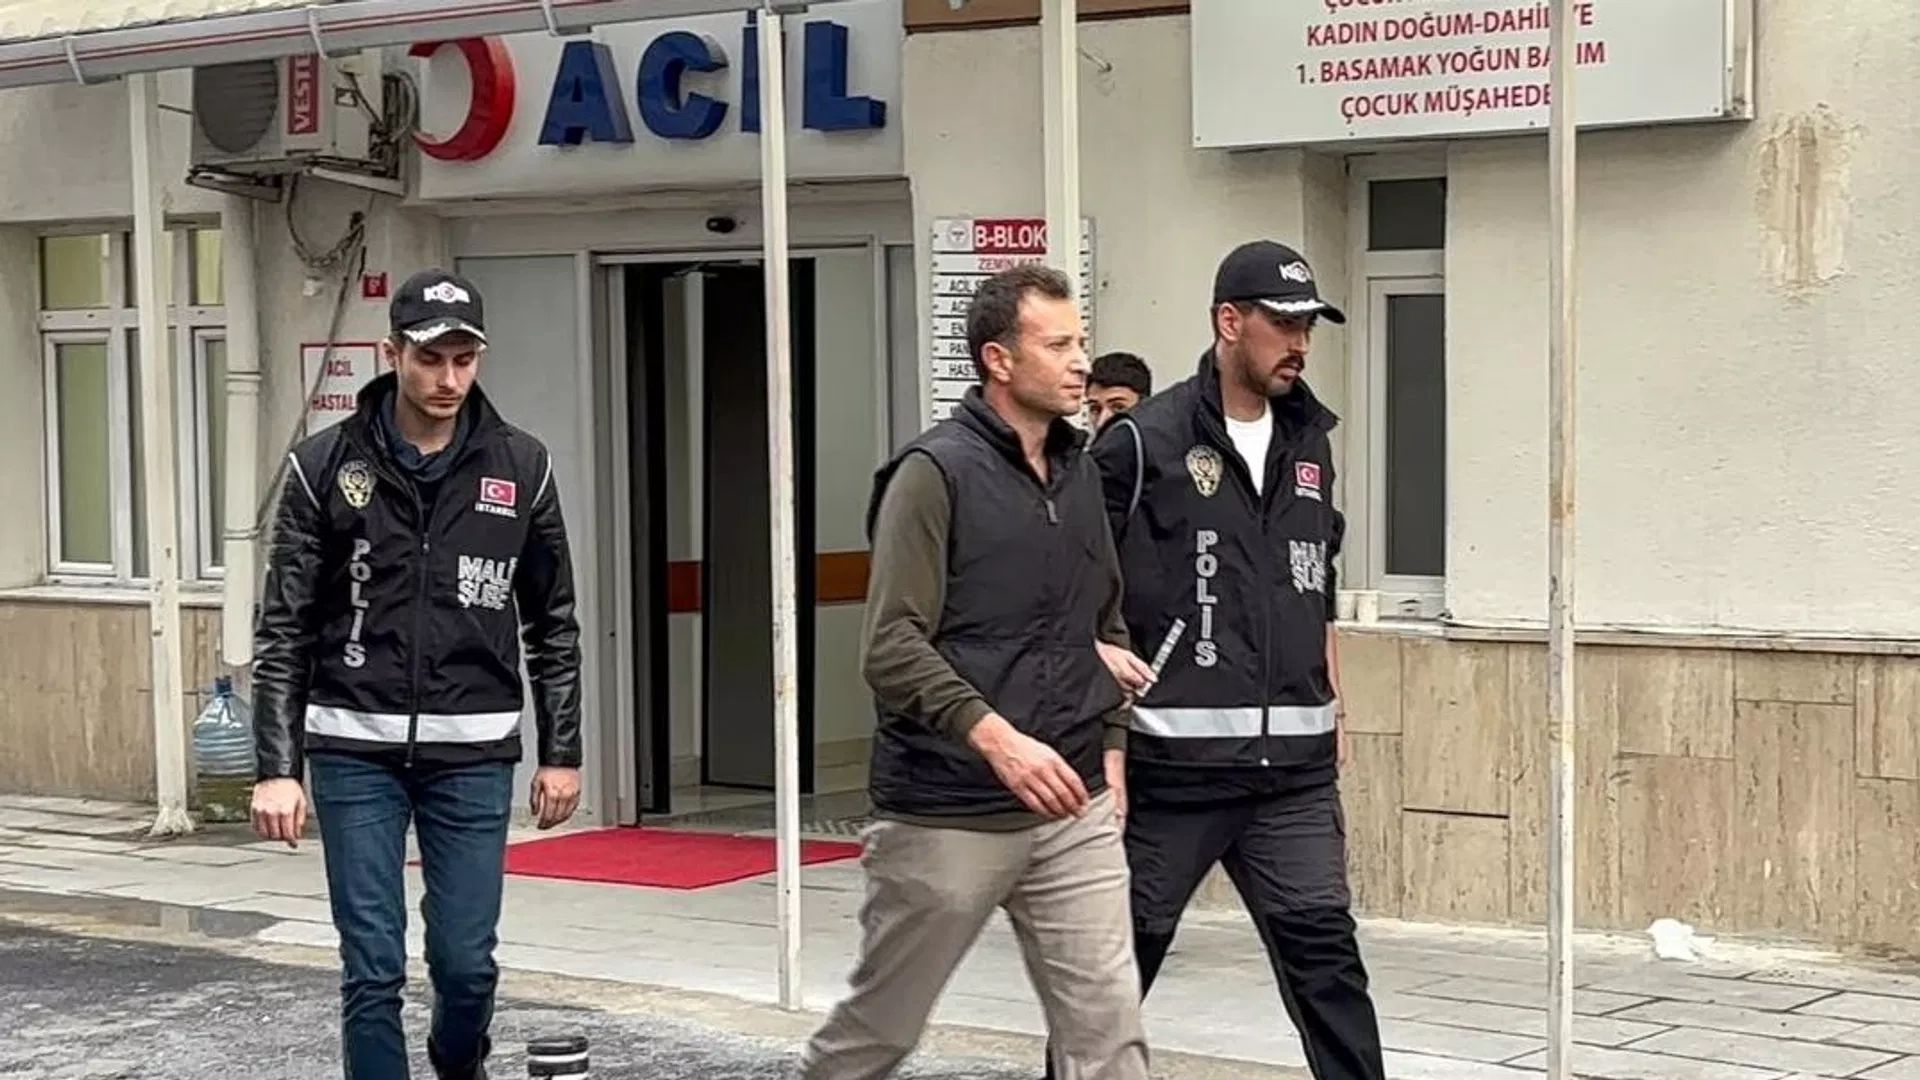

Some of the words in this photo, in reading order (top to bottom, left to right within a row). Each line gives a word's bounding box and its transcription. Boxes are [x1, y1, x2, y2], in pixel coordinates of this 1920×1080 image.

[1306, 20, 1378, 47] KADIN
[1383, 2, 1594, 44] DOĞUM-DAHİLE
[538, 10, 887, 147] ACİL
[1295, 63, 1316, 85] 1.
[1320, 54, 1433, 84] BASAMAK
[1436, 45, 1520, 75] YOĞUN
[1527, 41, 1606, 69] BAIM
[1340, 92, 1418, 125] ÇOCUK
[1424, 83, 1552, 117] MÜŞAHEDE
[975, 225, 1049, 249] B-BLOK
[312, 393, 356, 411] HASTAL
